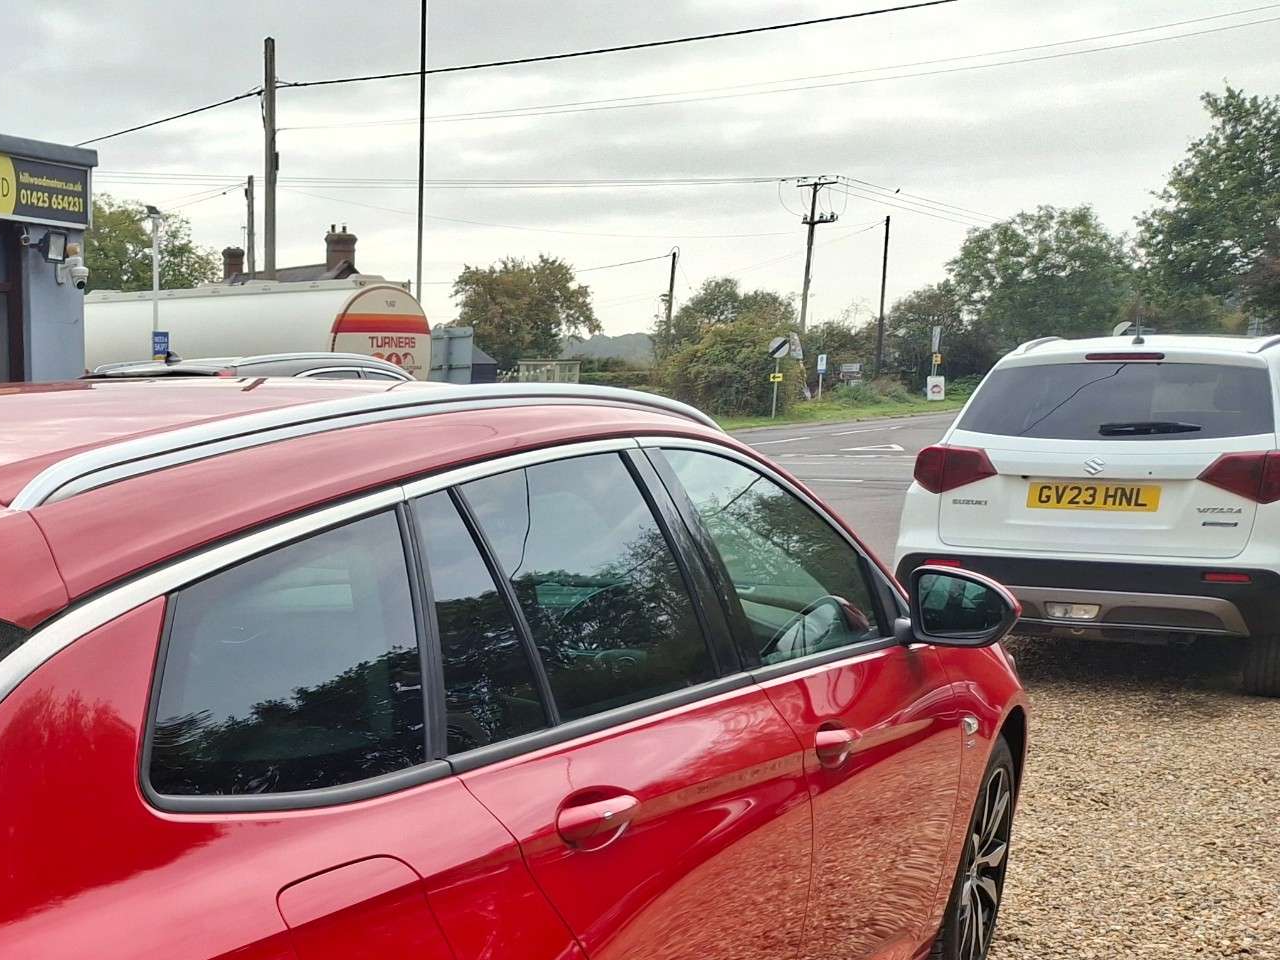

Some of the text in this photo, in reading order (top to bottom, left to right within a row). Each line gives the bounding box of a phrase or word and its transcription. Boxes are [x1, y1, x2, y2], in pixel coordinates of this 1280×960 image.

[20, 189, 83, 213] 01425 654231
[368, 336, 416, 349] TURNERS
[1037, 485, 1148, 507] GV23 HNL
